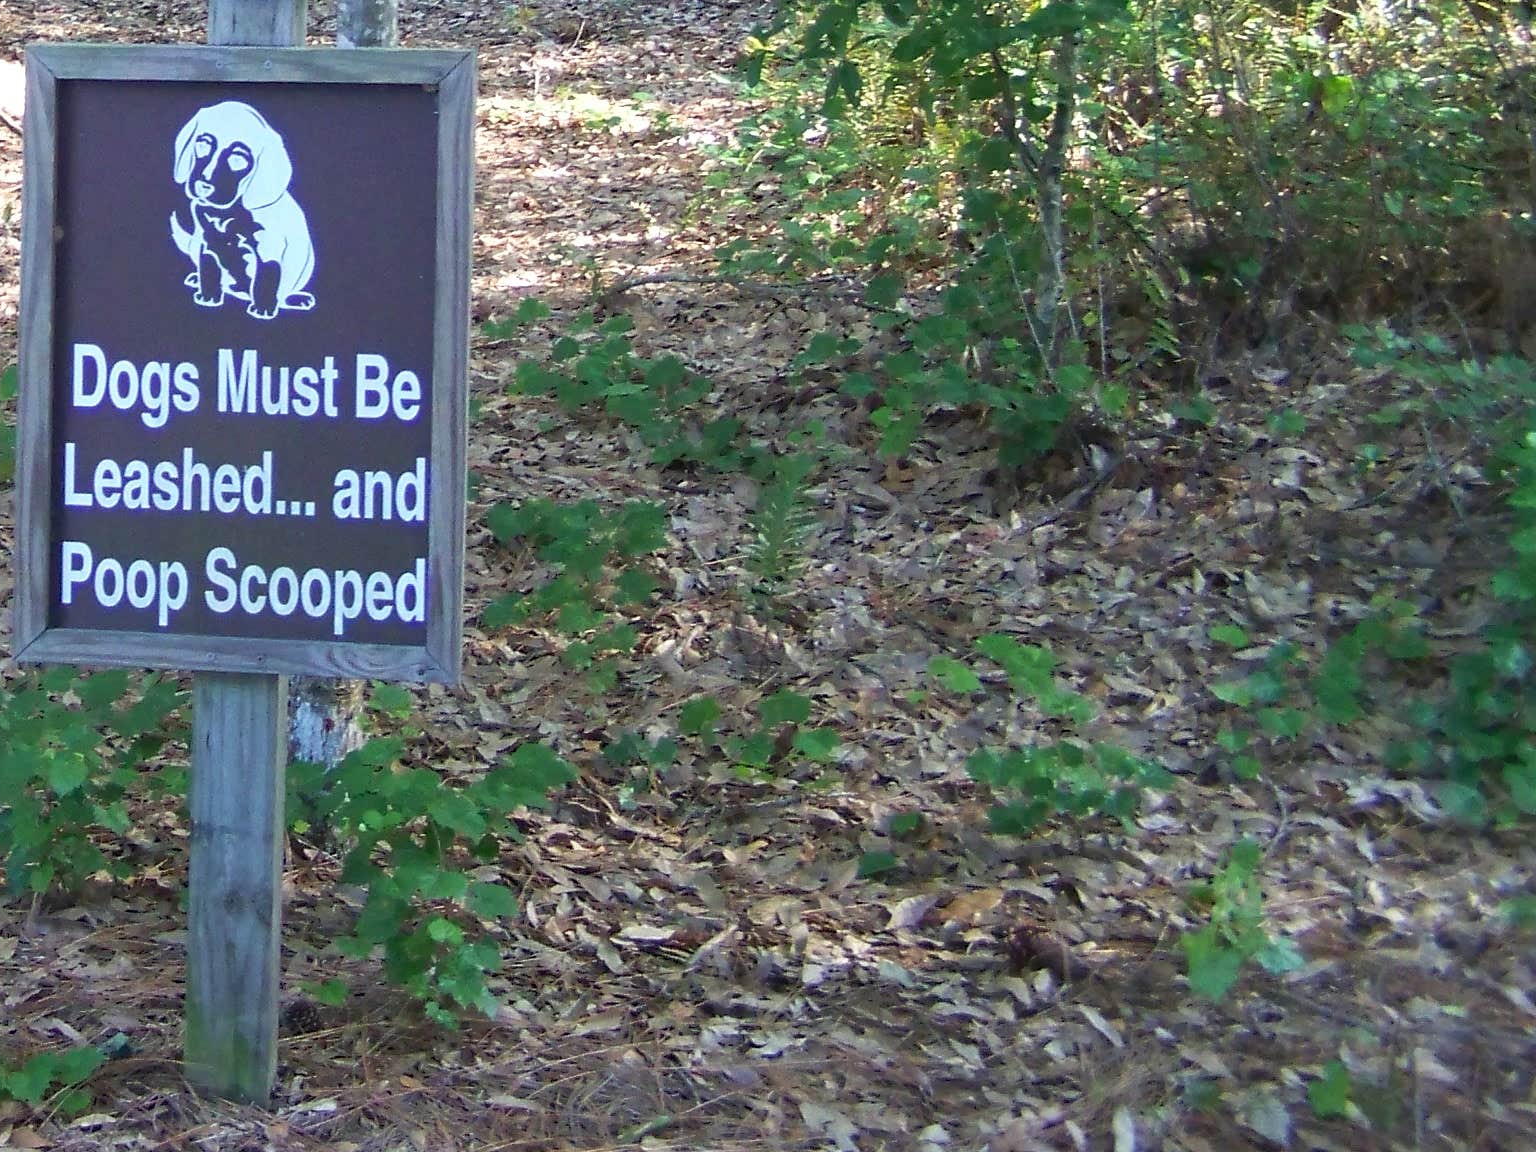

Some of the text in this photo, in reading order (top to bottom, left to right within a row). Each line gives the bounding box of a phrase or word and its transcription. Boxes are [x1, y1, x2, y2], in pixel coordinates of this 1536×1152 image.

[72, 343, 422, 428] Dogs Must Be
[64, 442, 427, 522] Leashed... and
[61, 541, 427, 636] Poop Scooped
